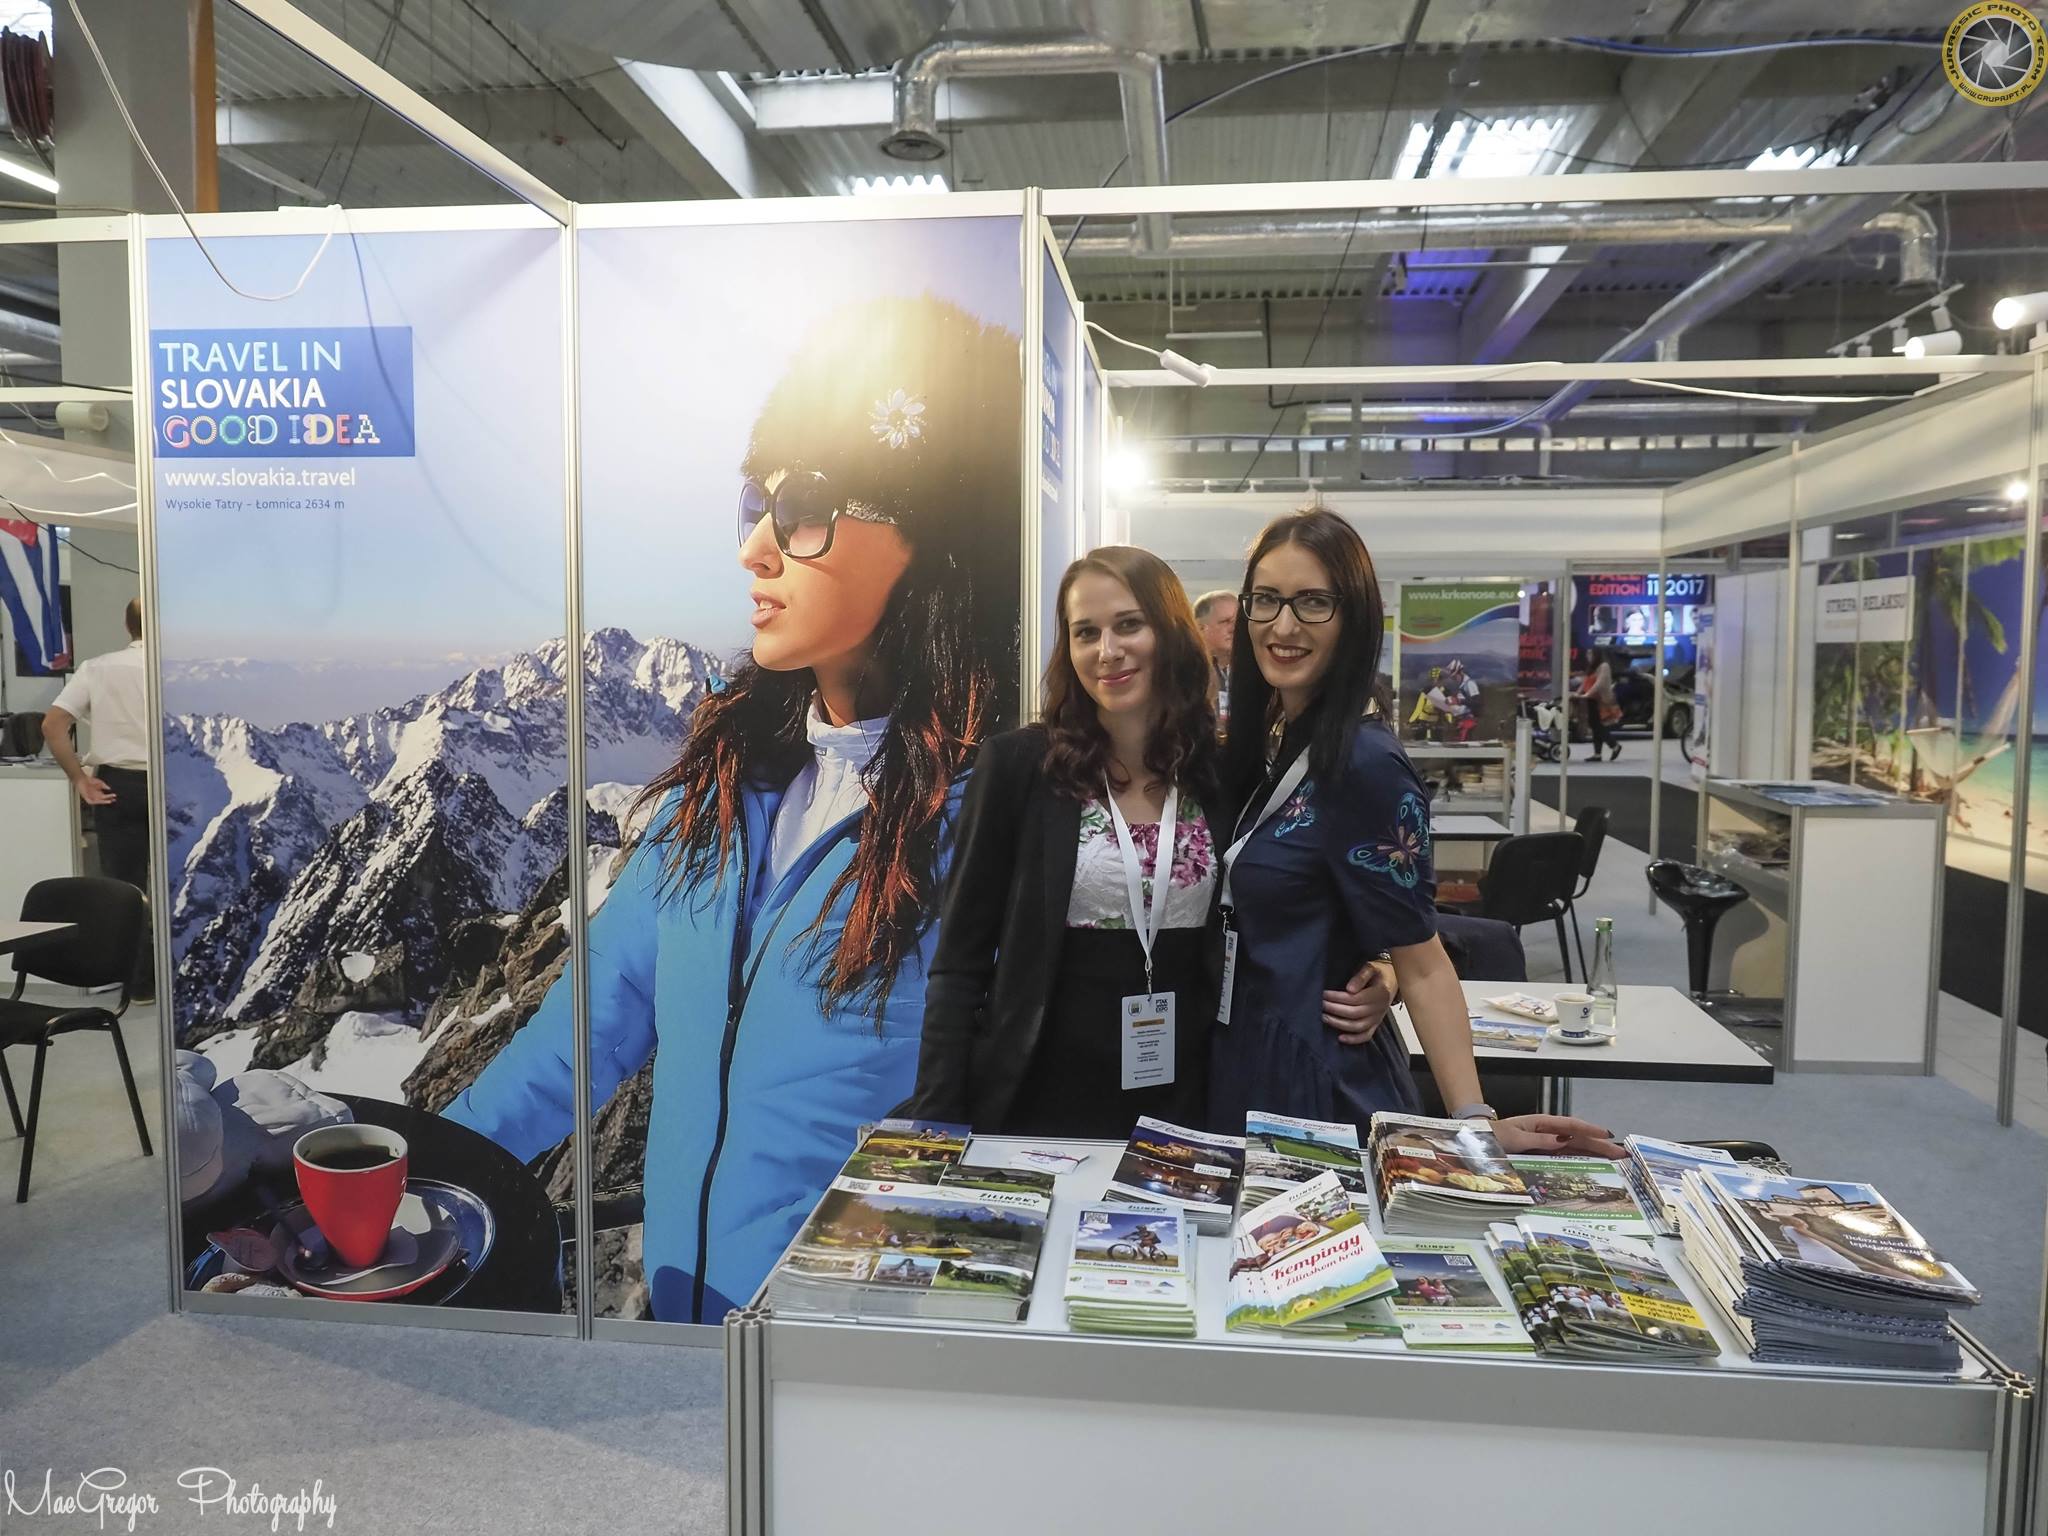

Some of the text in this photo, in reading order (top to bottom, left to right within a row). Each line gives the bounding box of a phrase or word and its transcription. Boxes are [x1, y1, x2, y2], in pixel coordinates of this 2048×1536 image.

[159, 341, 342, 372] TRAVEL IN
[160, 377, 327, 409] SLOVAKIA
[162, 413, 381, 449] GOOD IDEA
[164, 468, 356, 487] www.slovakia.travel
[165, 498, 212, 511] Wysokie
[215, 498, 243, 511] Tatry
[255, 498, 302, 510] Łomnica
[305, 498, 331, 510] 2634
[333, 501, 345, 510] m
[1408, 589, 1515, 600] www.krkonose.eu
[1588, 583, 1640, 596] EDITION
[1271, 1234, 1361, 1281] Kempingy
